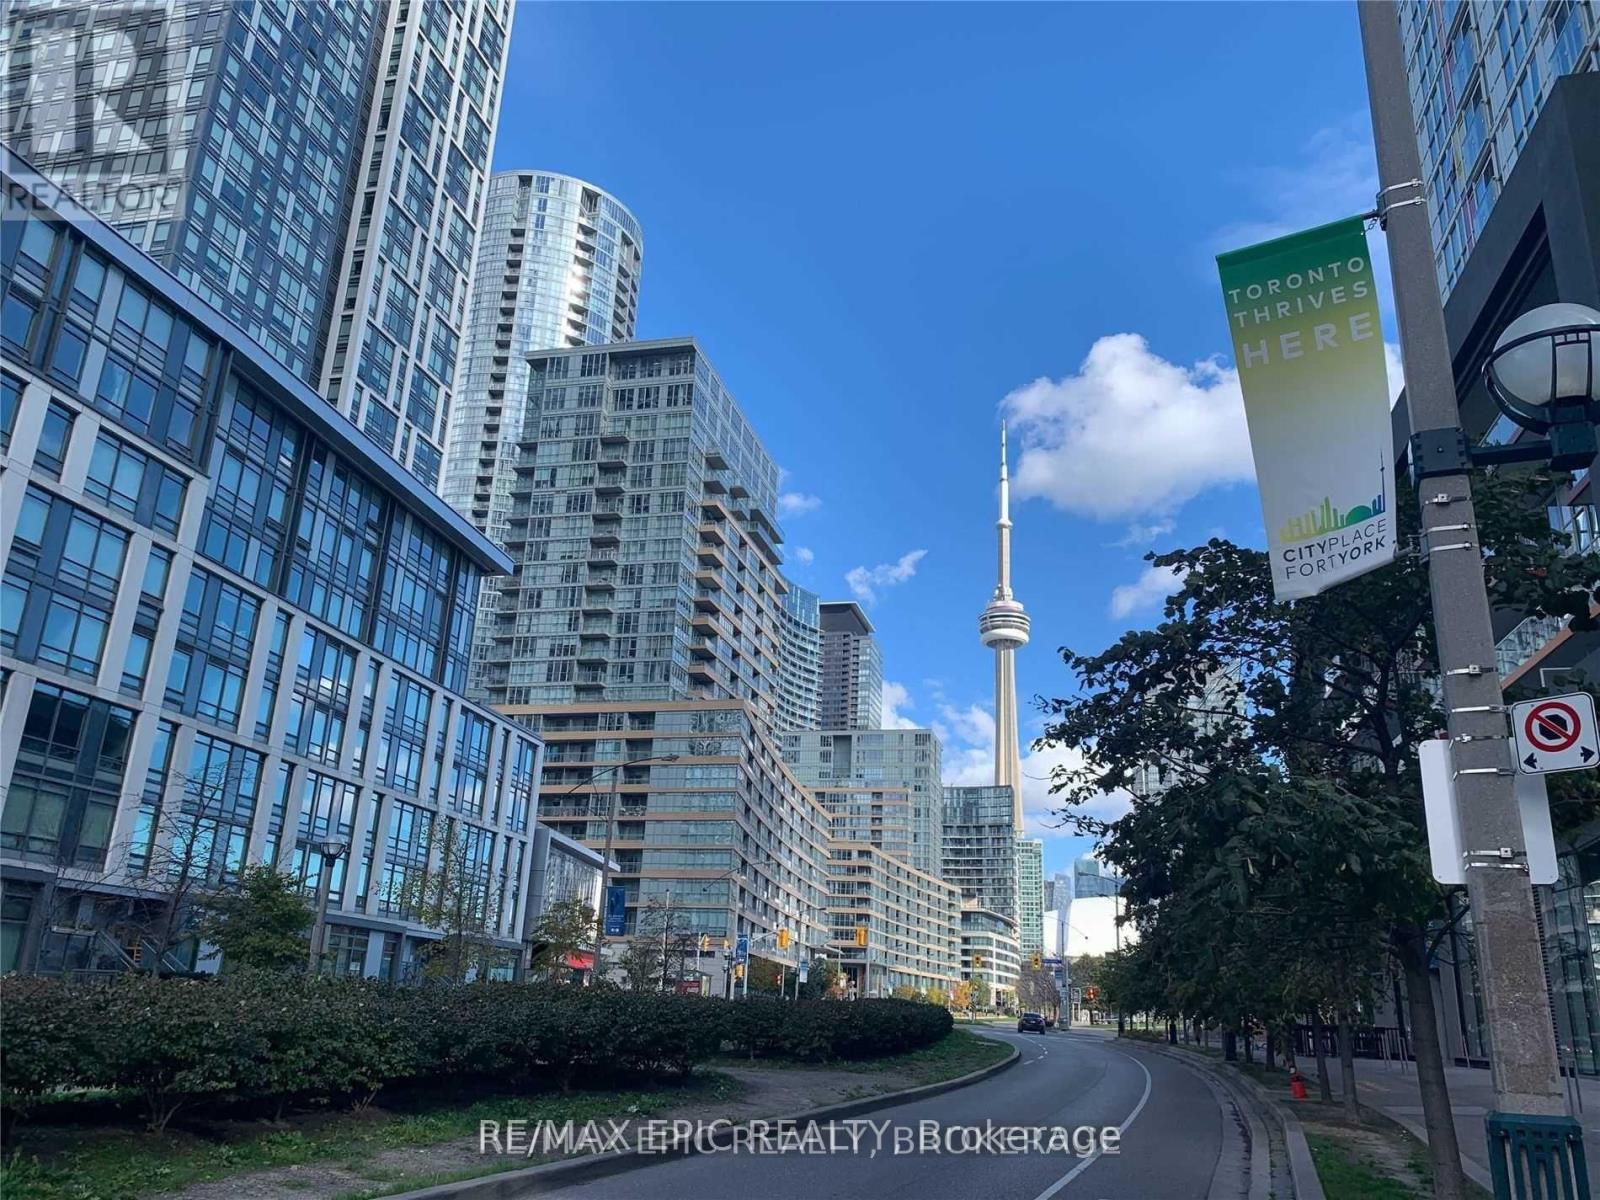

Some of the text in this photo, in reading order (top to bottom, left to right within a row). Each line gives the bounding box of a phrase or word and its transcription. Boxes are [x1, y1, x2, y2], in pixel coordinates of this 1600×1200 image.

[1228, 256, 1365, 304] TORONTO
[1233, 280, 1369, 328] THRIVES
[1242, 312, 1374, 369] HERE
[1283, 518, 1387, 562] CITYPLACE
[1286, 535, 1386, 580] FORTYORK
